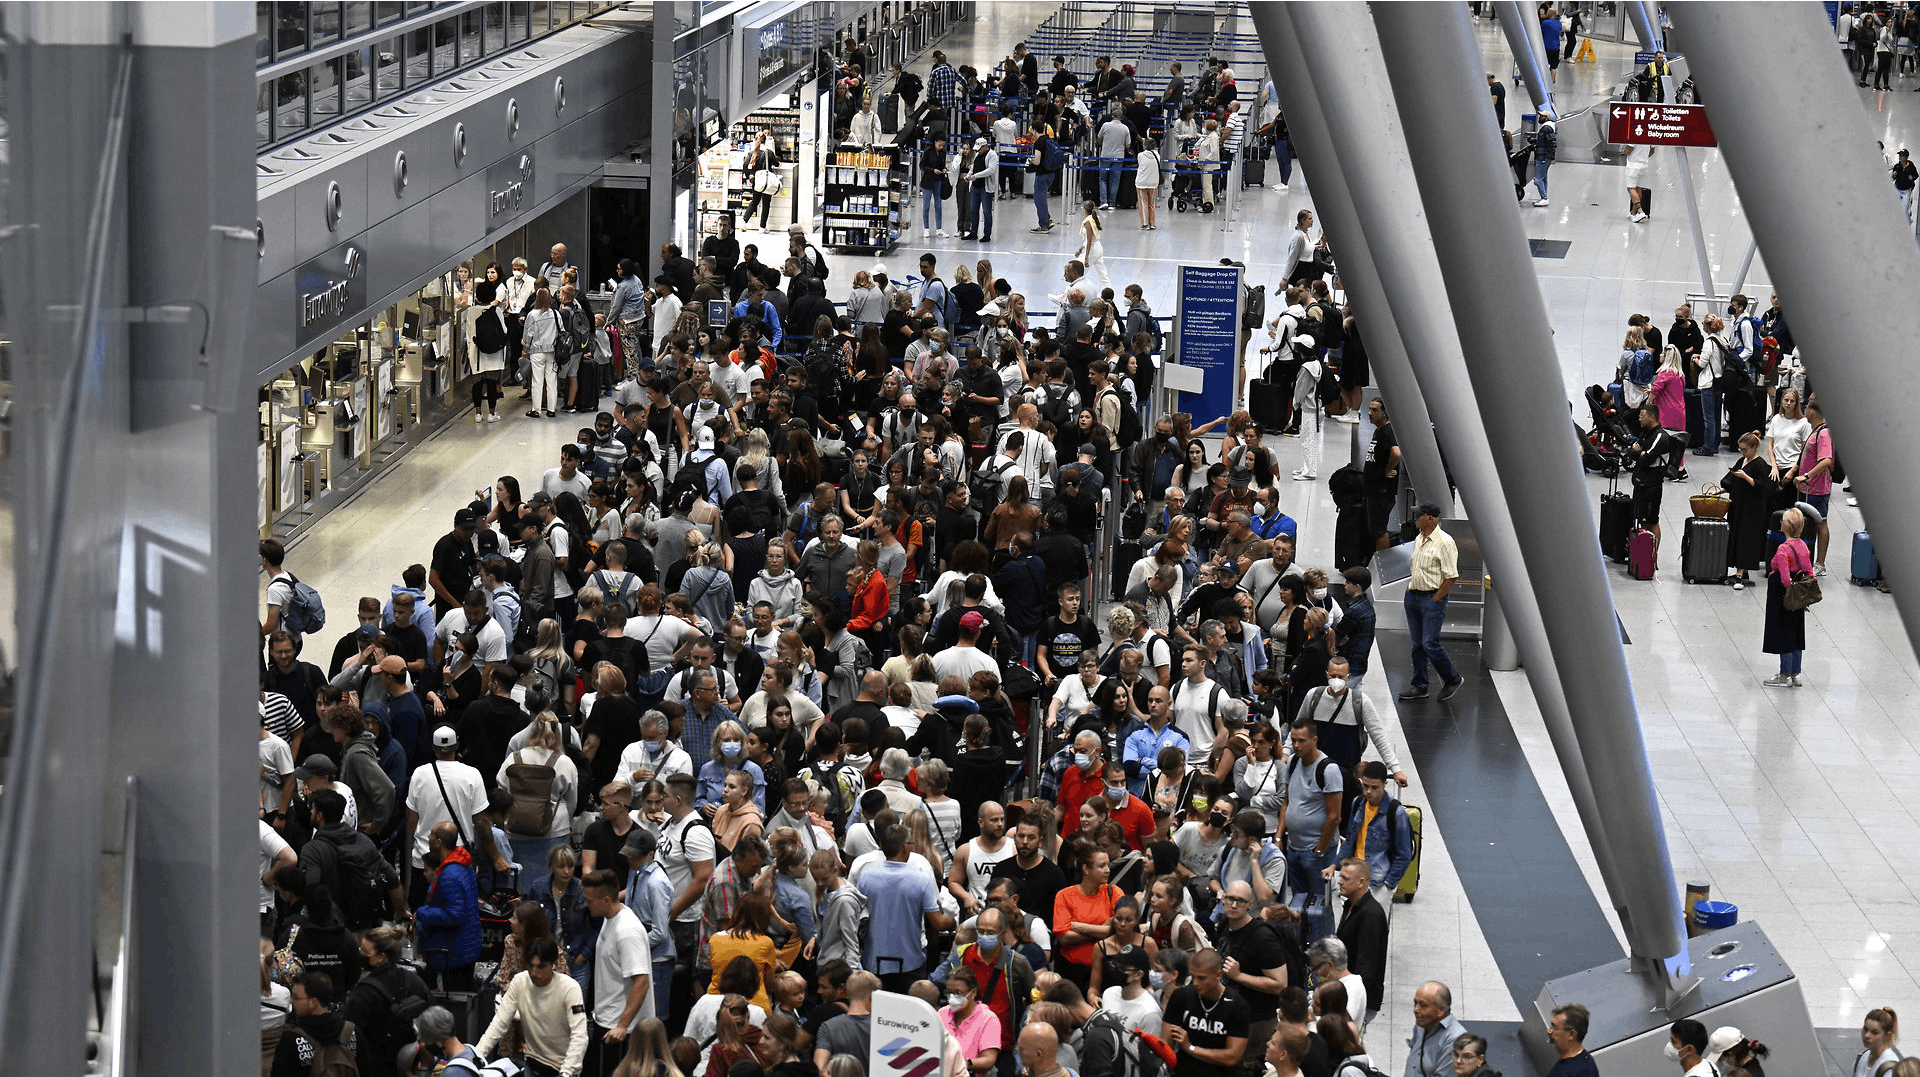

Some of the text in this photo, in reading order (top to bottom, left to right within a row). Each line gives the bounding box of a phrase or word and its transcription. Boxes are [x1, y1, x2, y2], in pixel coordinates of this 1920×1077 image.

[1648, 130, 1662, 139] Baby
[490, 180, 523, 218] Eurowings
[302, 280, 349, 328] Eurowings
[877, 1016, 920, 1034] Eurowings
[1189, 1015, 1228, 1035] BALR.
